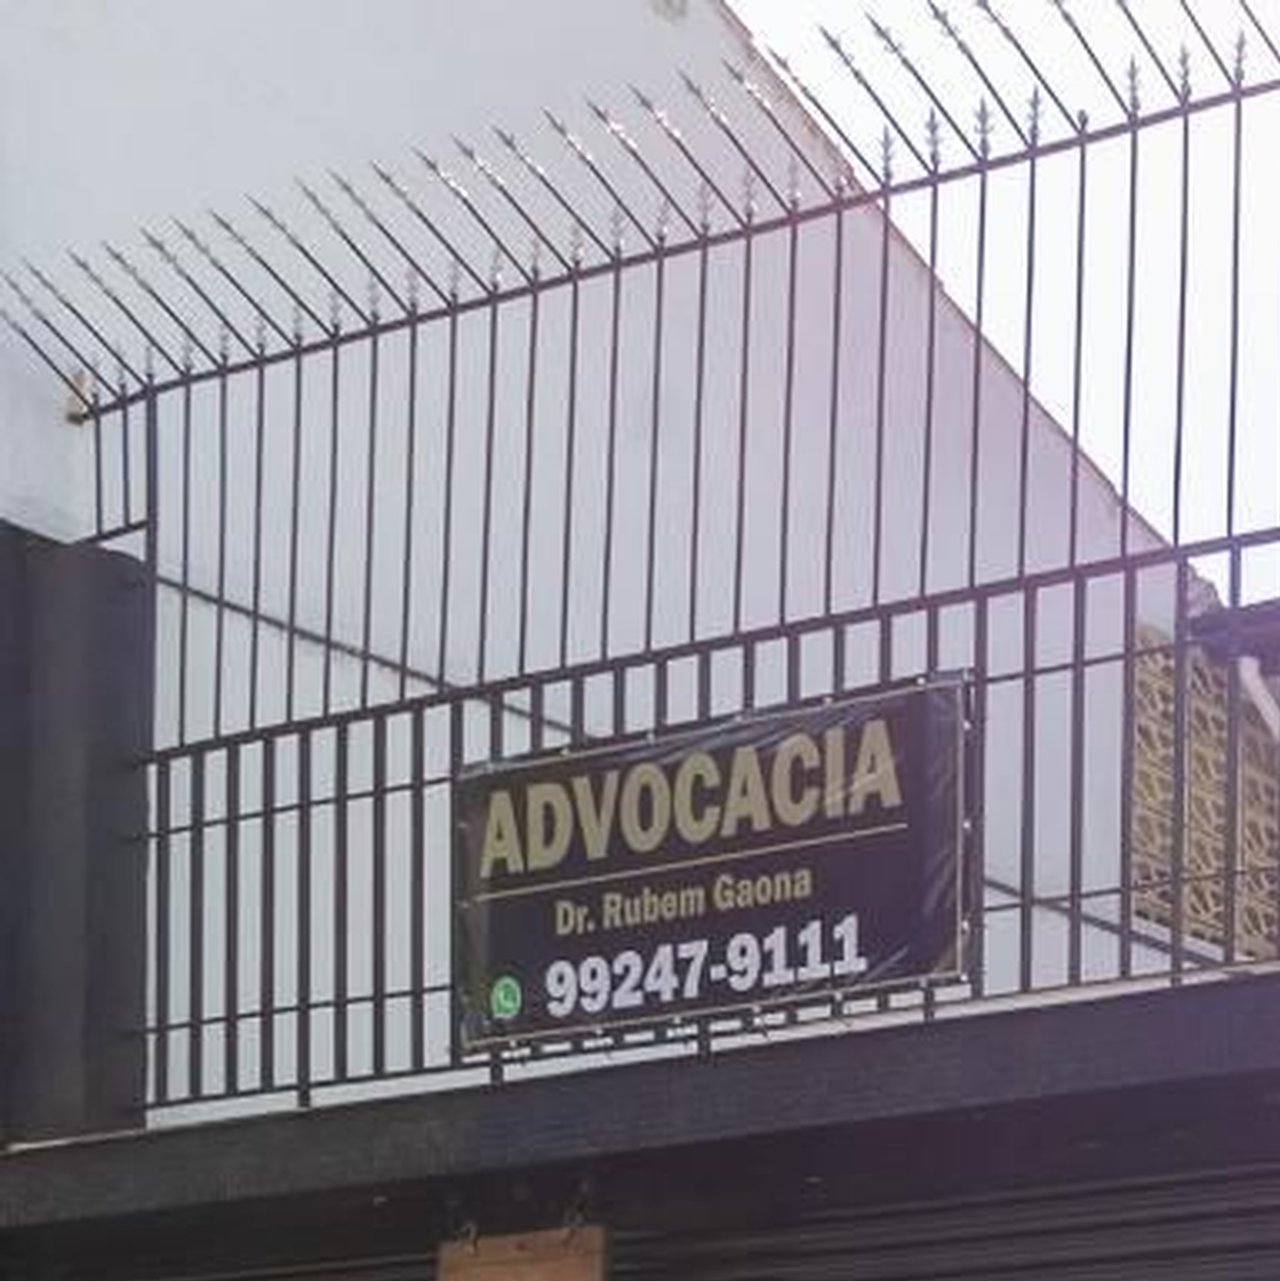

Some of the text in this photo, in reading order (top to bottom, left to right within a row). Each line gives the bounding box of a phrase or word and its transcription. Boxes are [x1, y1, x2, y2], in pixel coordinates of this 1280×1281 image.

[480, 719, 901, 878] ADVOCACIA
[556, 868, 812, 937] Dr. Rubem Gaona
[545, 913, 868, 1018] 99247-9111
